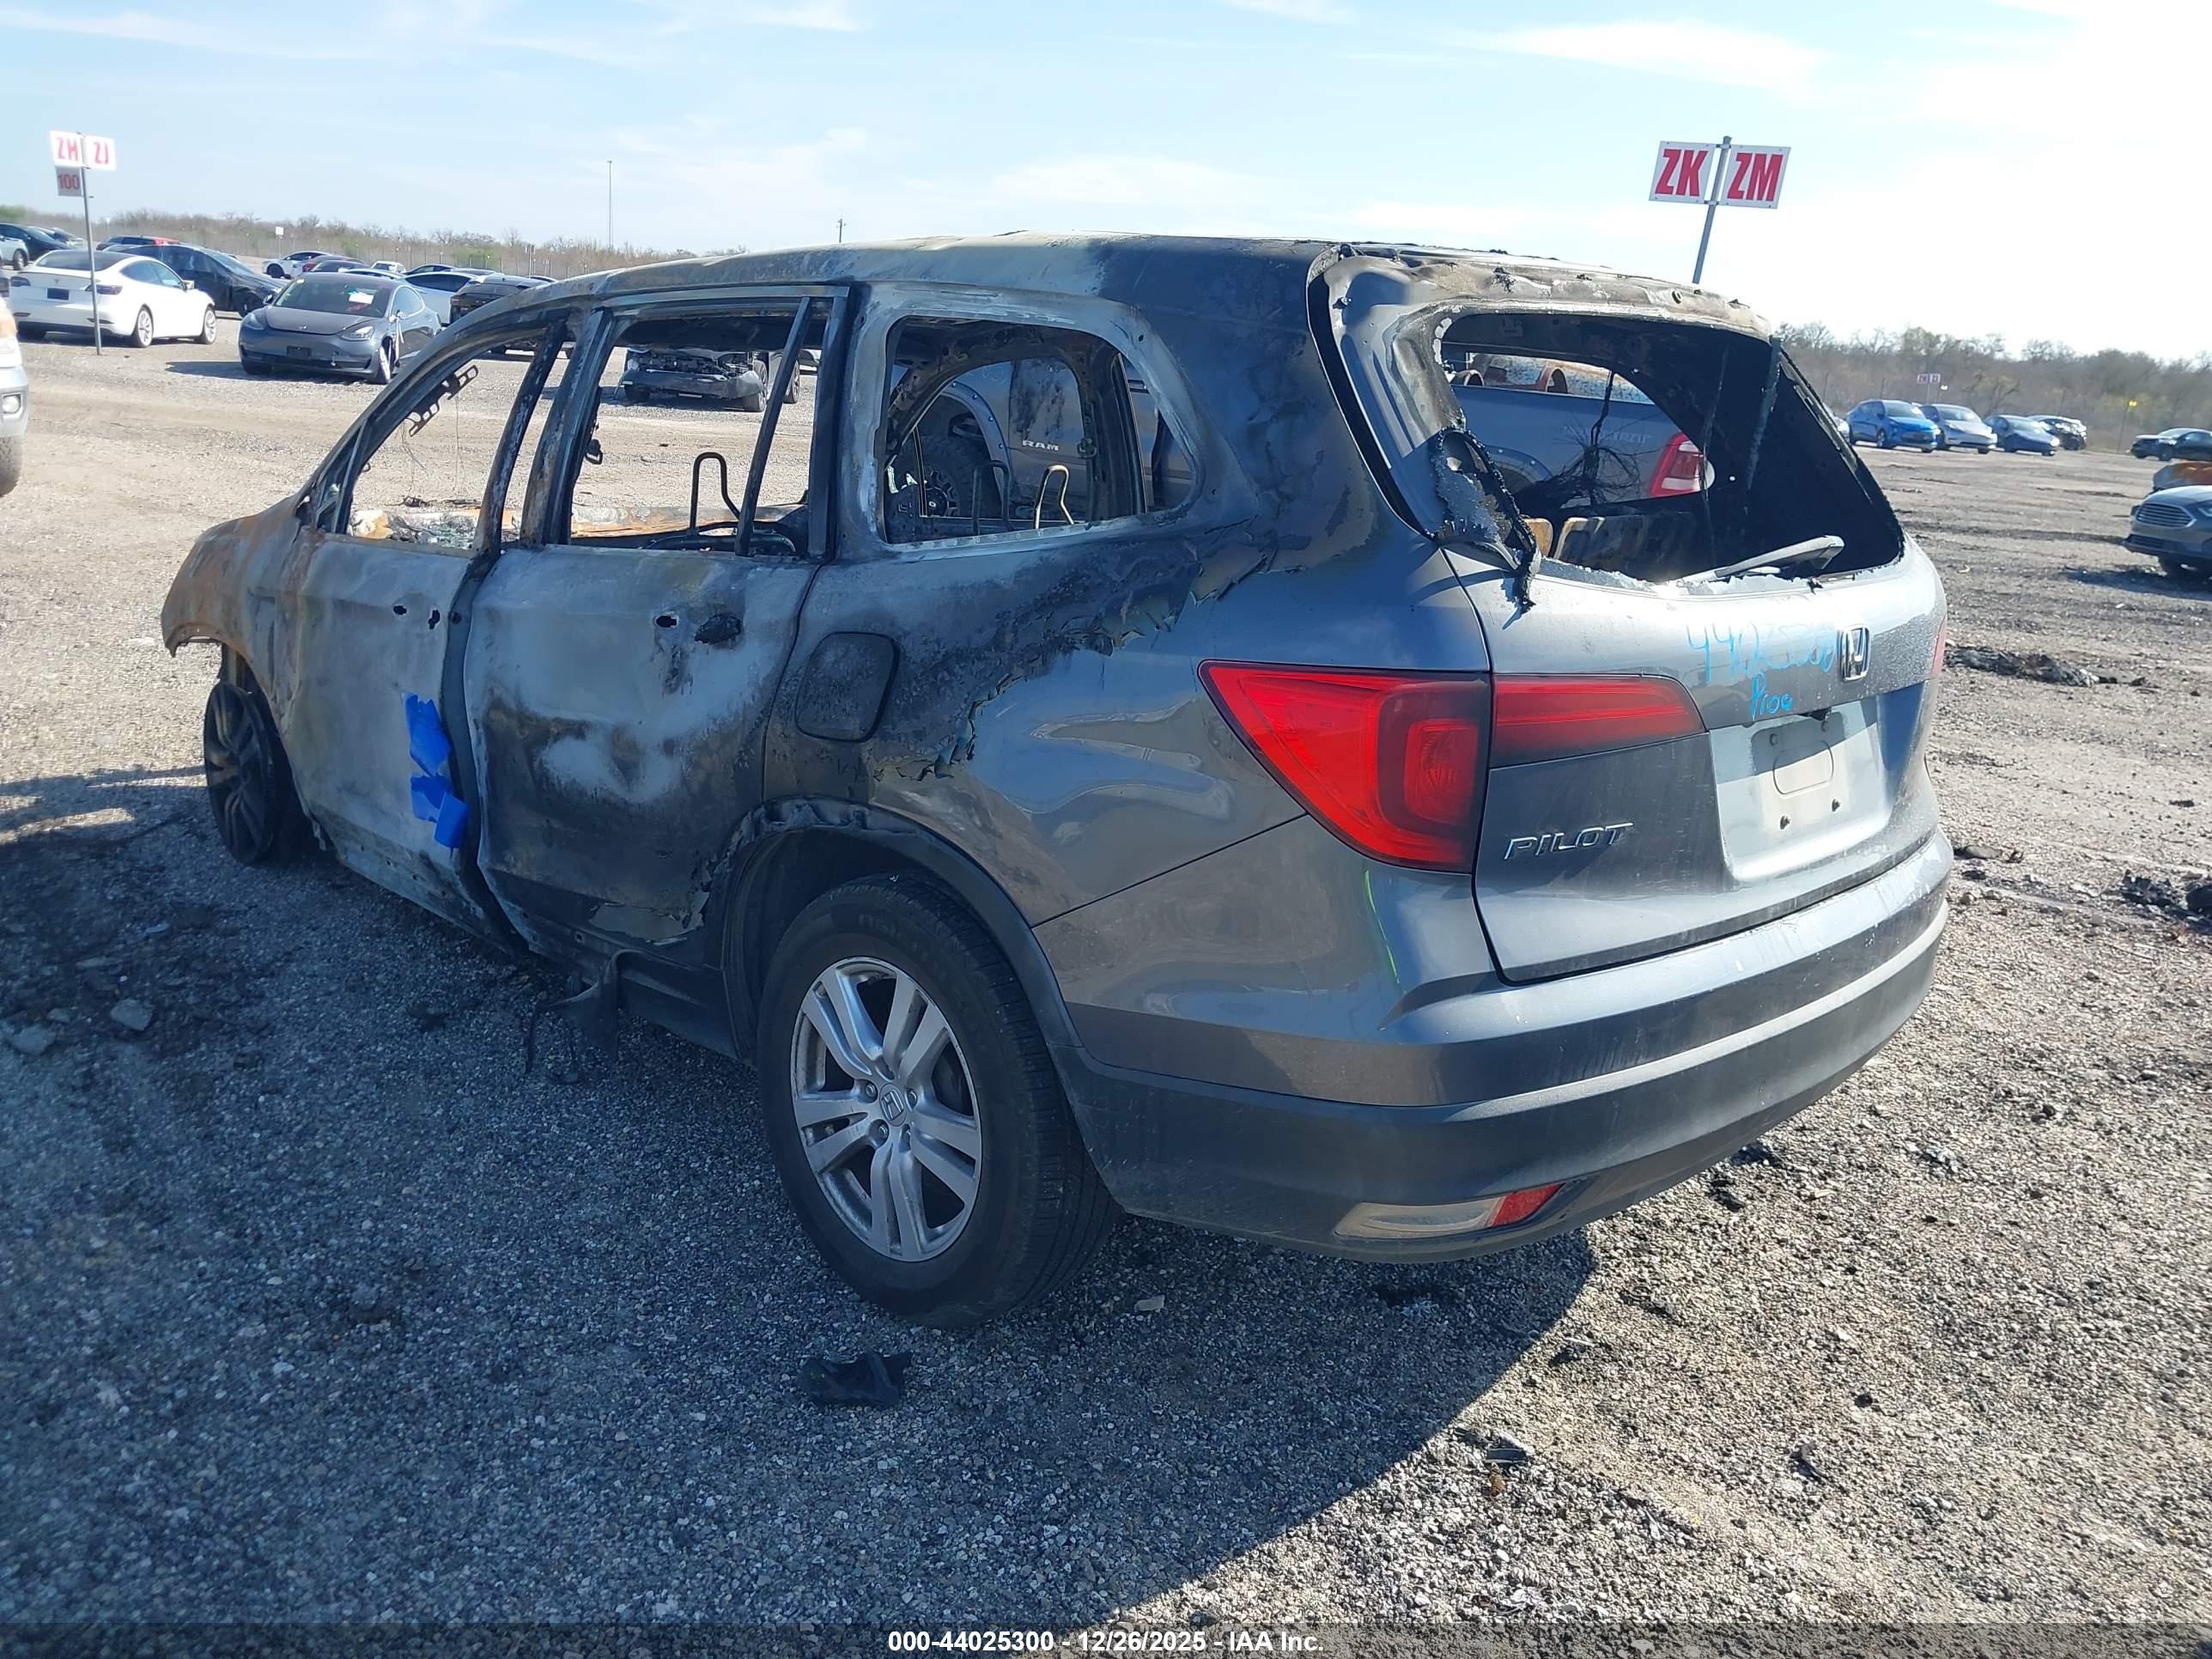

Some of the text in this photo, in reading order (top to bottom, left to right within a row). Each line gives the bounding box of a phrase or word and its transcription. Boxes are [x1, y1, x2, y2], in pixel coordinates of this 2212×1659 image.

[58, 173, 80, 191] 100
[1655, 149, 1709, 197] ZK
[1727, 152, 1784, 203] ZM
[1022, 440, 1059, 452] RAM
[1504, 822, 1635, 860] PILOT
